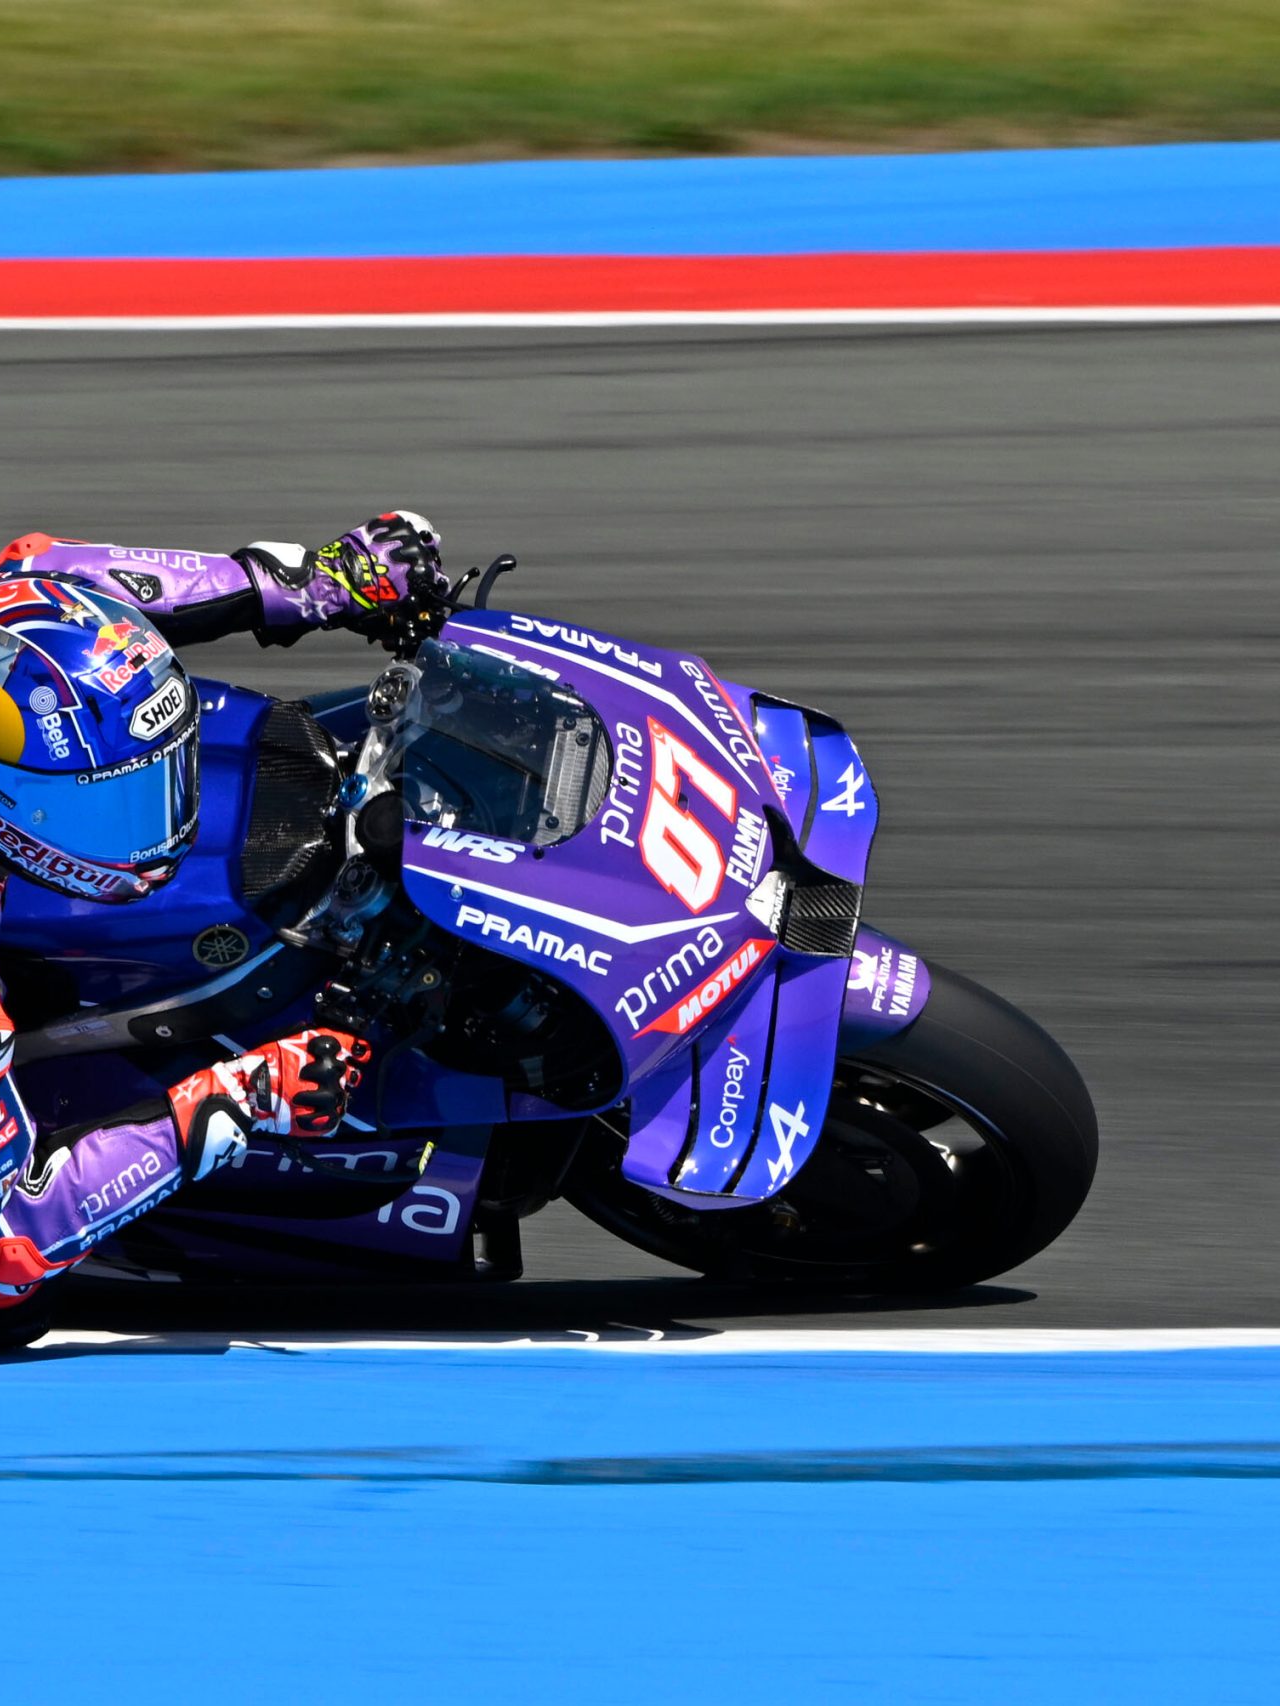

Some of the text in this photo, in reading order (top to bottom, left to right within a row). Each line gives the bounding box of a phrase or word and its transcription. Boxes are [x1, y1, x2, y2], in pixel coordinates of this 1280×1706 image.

[109, 548, 207, 572] prima
[510, 614, 662, 678] PRAMAC
[42, 712, 70, 758] Beta
[141, 686, 182, 732] SHOEI
[163, 724, 197, 756] PRAMAC
[679, 661, 760, 767] prima
[92, 759, 149, 782] PRAMAC
[601, 722, 643, 848] prima
[422, 827, 526, 863] WRS
[638, 715, 739, 915] 07
[725, 807, 764, 887] FIAMM
[130, 834, 178, 863] Borusan
[456, 905, 612, 976] PRAMAC
[615, 926, 724, 1030] prima
[678, 942, 761, 1031] MOTUL
[871, 946, 893, 1012] PRAMAC
[889, 953, 917, 1016] YAMAHA
[710, 1046, 750, 1148] Corpay
[79, 1151, 161, 1222] prima
